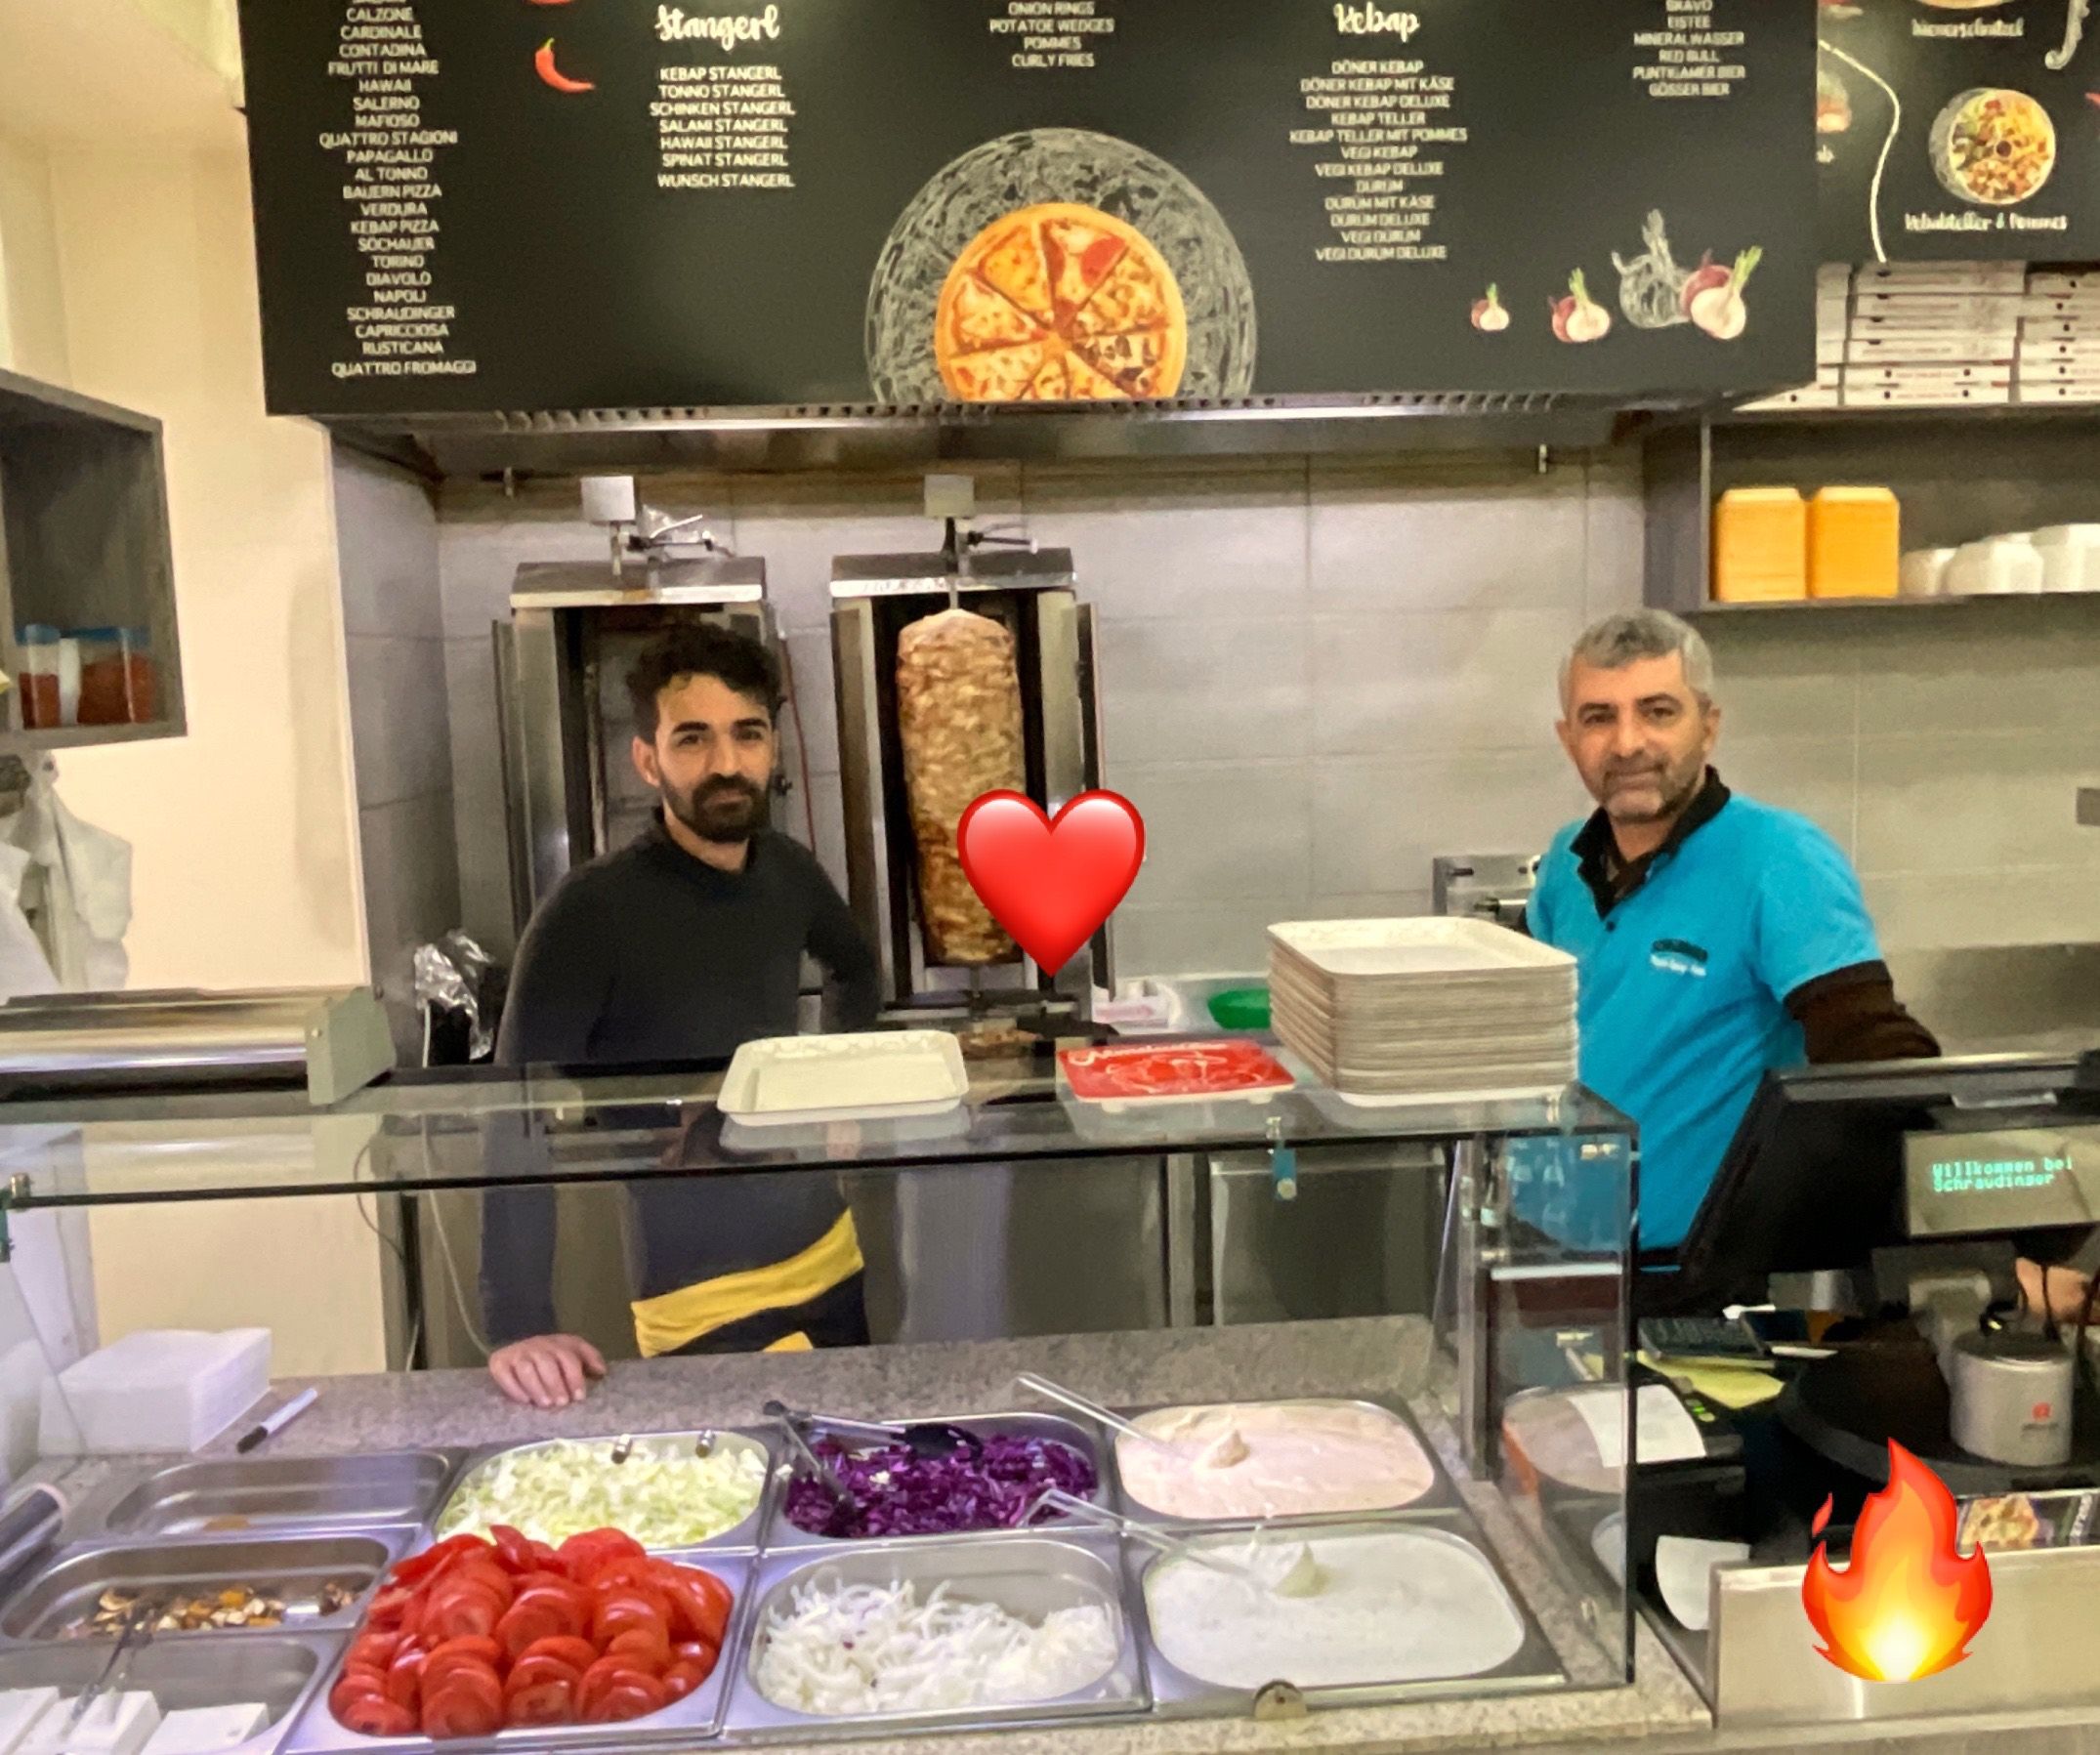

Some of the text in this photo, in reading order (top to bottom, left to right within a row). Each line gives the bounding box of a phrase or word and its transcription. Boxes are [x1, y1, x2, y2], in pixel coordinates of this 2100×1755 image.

[347, 8, 413, 21] CALZONE
[1008, 1, 1095, 15] ONION RINGS
[654, 4, 780, 51] Stangerl
[989, 19, 1114, 32] POTATOE WEDGES
[1667, 15, 1711, 28] EISTEE
[340, 24, 422, 40] CARDINALE
[1024, 36, 1081, 50] POMMES
[339, 44, 426, 58] CONTADINA
[1659, 49, 1720, 63] RED BULL
[1012, 53, 1095, 67] CURLY FRIES
[1331, 60, 1424, 73] DÖNER KEBAP
[328, 60, 439, 75] FRUTTI DI MARE
[660, 66, 781, 81] KEBAP STANGERL
[1717, 65, 1745, 79] BIER
[358, 78, 411, 92] HAWAII
[1300, 75, 1454, 92] DÖNER KEBAP MIT KÄSE
[1649, 82, 1730, 96] GÖSSER BIER
[657, 84, 784, 98] TONNO STANGERL
[353, 96, 420, 110] SALERNO
[1306, 94, 1450, 109] DÖNER KEBAP DELUXE
[650, 102, 796, 116] SCHINKEN STANGERL
[355, 114, 420, 128] MAFIOSO
[1331, 111, 1426, 125] KEBAP TELLER
[659, 119, 788, 133] SALAMI STANGERL
[319, 131, 458, 148] QUATTRO STAGIONI
[660, 136, 788, 149] HAWAII STANGERL
[1289, 128, 1468, 144] KEBAP TELLER MIT POMMES
[347, 148, 434, 163] PAPAGALLO
[1373, 146, 1418, 158] KEBAP
[662, 153, 788, 167] SPINAT STANGERL
[355, 167, 428, 182] AL TONNO
[1347, 163, 1391, 176] KEBAP
[1393, 161, 1444, 175] DELUXE
[657, 174, 796, 188] WUNSCH STANGERL
[343, 185, 441, 199] BAUERN PIZZA
[360, 202, 428, 216] VERDURA
[1374, 195, 1397, 209] MIT
[1379, 213, 1430, 226] DELUXE
[351, 220, 440, 234] KEBAP PIZZA
[1397, 245, 1448, 260] DELUXE
[371, 255, 424, 269] TORINO
[365, 272, 432, 286] DIAVOLO
[373, 290, 427, 303] NAPOLI
[347, 307, 455, 320] SCHRAUDINGER
[361, 341, 444, 355] RUSTICANA
[332, 360, 477, 378] QUATTRO FROMAGGI
[1932, 1156, 2072, 1177] Willkommen bei
